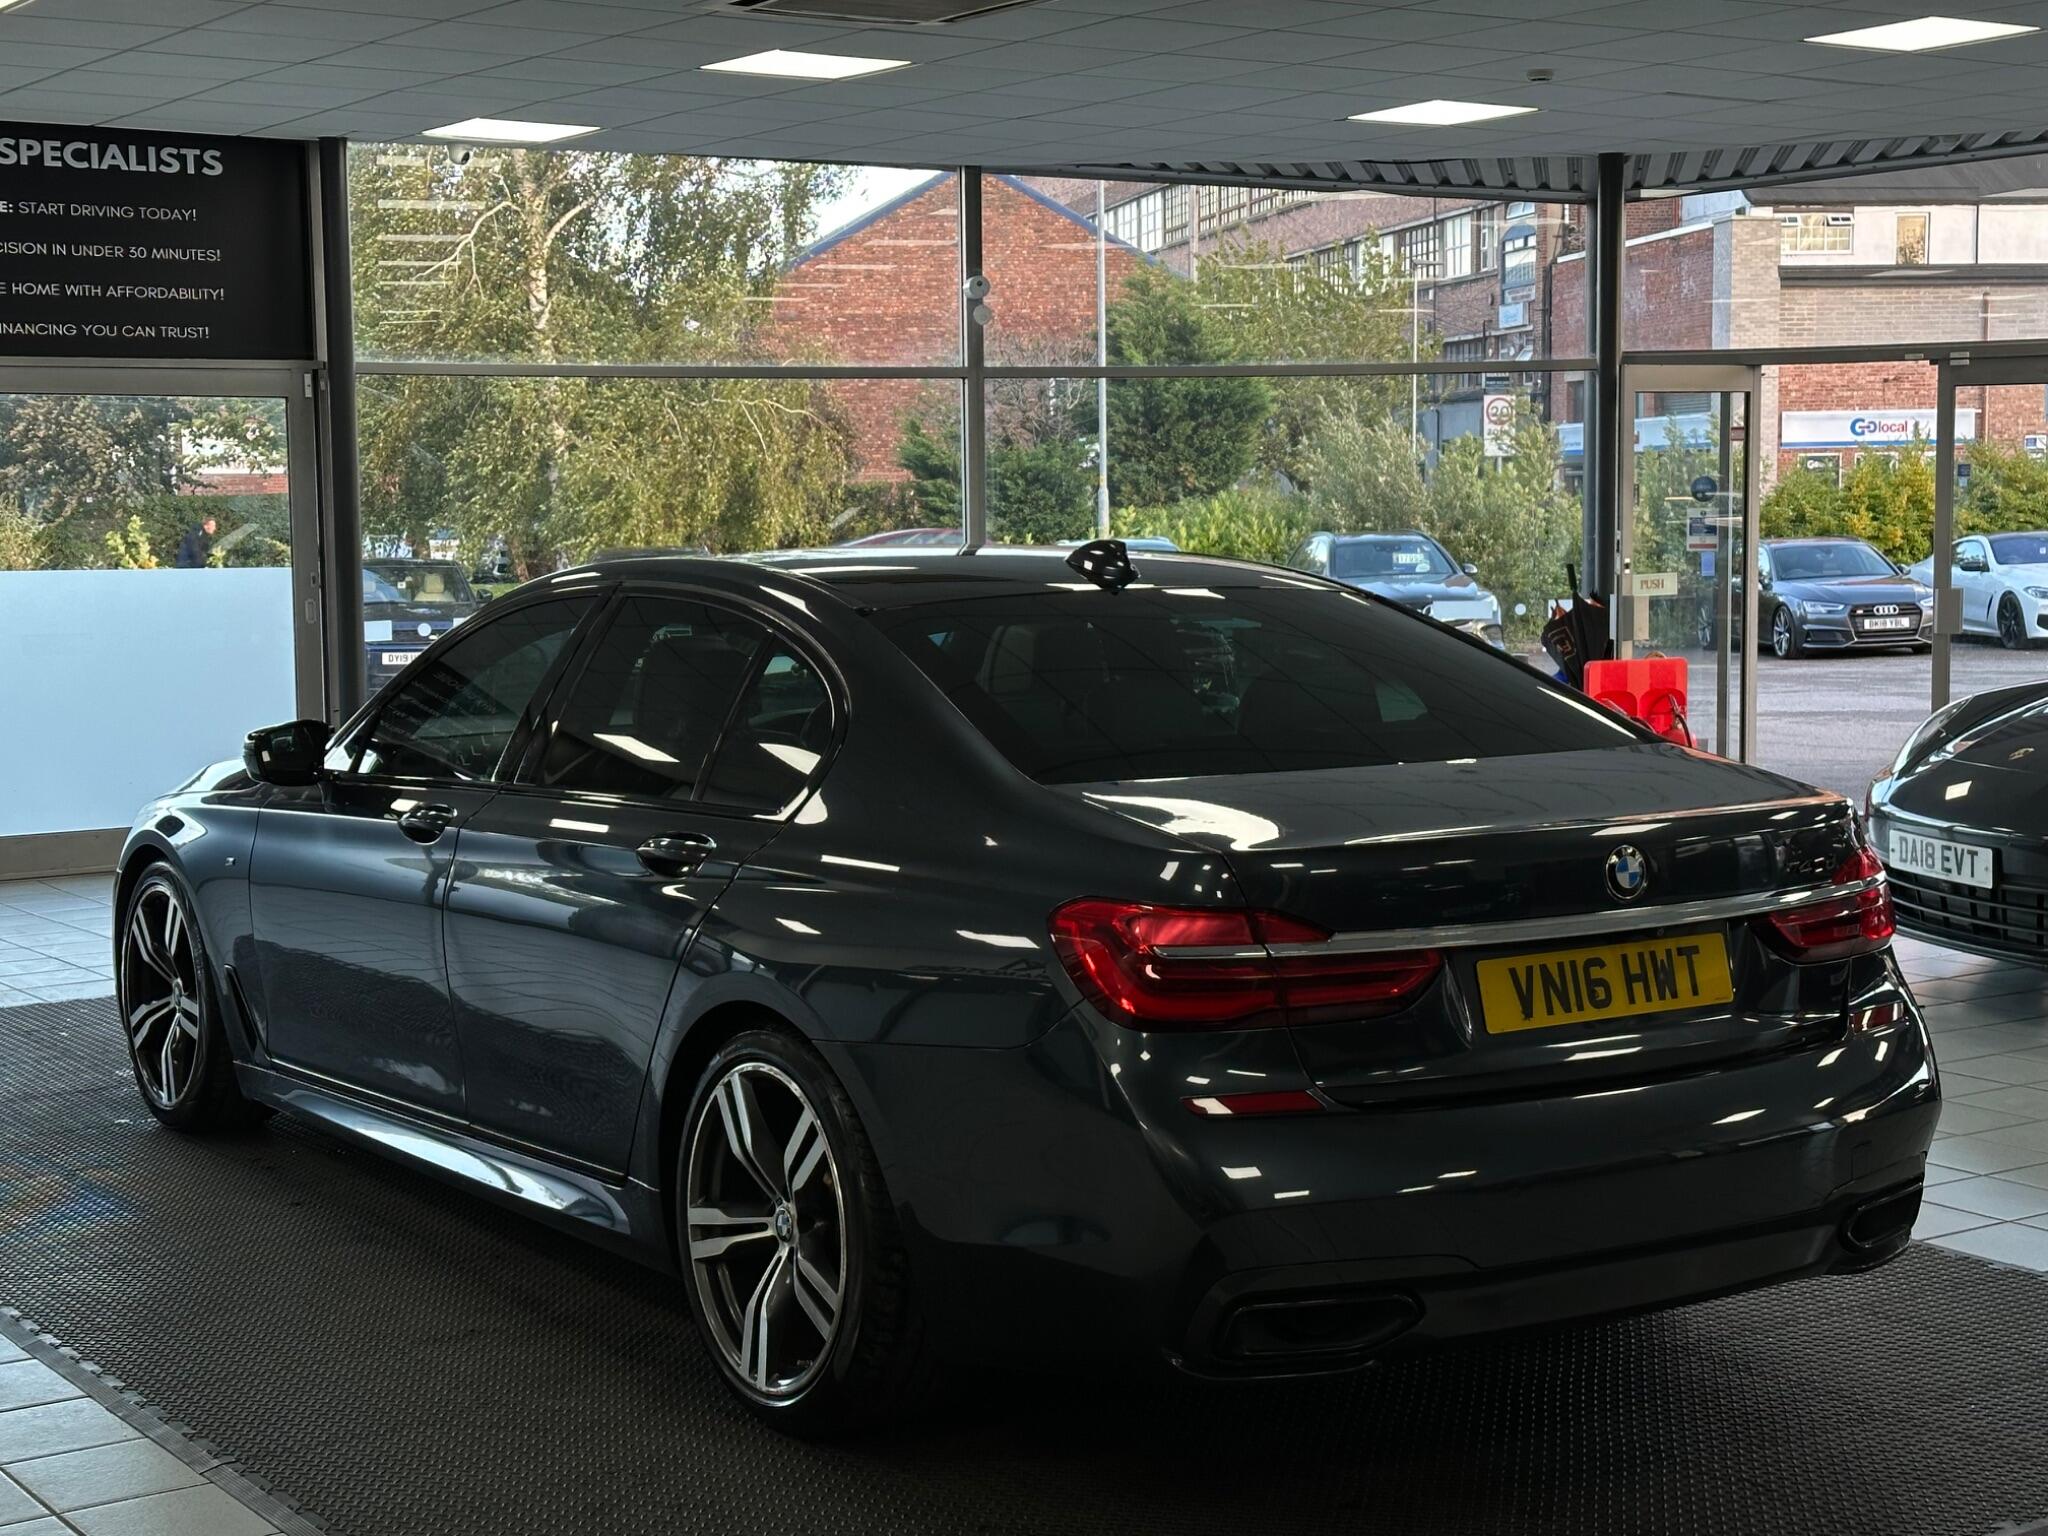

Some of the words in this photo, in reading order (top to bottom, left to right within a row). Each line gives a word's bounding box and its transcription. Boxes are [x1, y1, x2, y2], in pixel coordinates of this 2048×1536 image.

[0, 137, 223, 176] SPECIALISTS
[18, 201, 65, 215] START
[70, 204, 134, 218] DRIVING
[138, 207, 197, 221] TODAY!
[52, 244, 66, 255] IN
[71, 244, 124, 258] UNDER
[128, 247, 147, 259] 30
[151, 248, 221, 262] MINUTES!
[12, 282, 60, 296] HOME
[65, 284, 101, 296] WITH
[106, 285, 225, 301] AFFORDABILITY!
[82, 324, 117, 336] YOU
[122, 326, 156, 338] CAN
[160, 326, 210, 339] TRUST!
[1490, 405, 1510, 417] 20
[1640, 579, 1665, 590] PUSH
[388, 654, 409, 662] DY19
[1898, 835, 1936, 869] DA18
[1940, 844, 1979, 878] EVT
[1508, 956, 1613, 1022] VN16
[1621, 945, 1701, 1006] HWT
